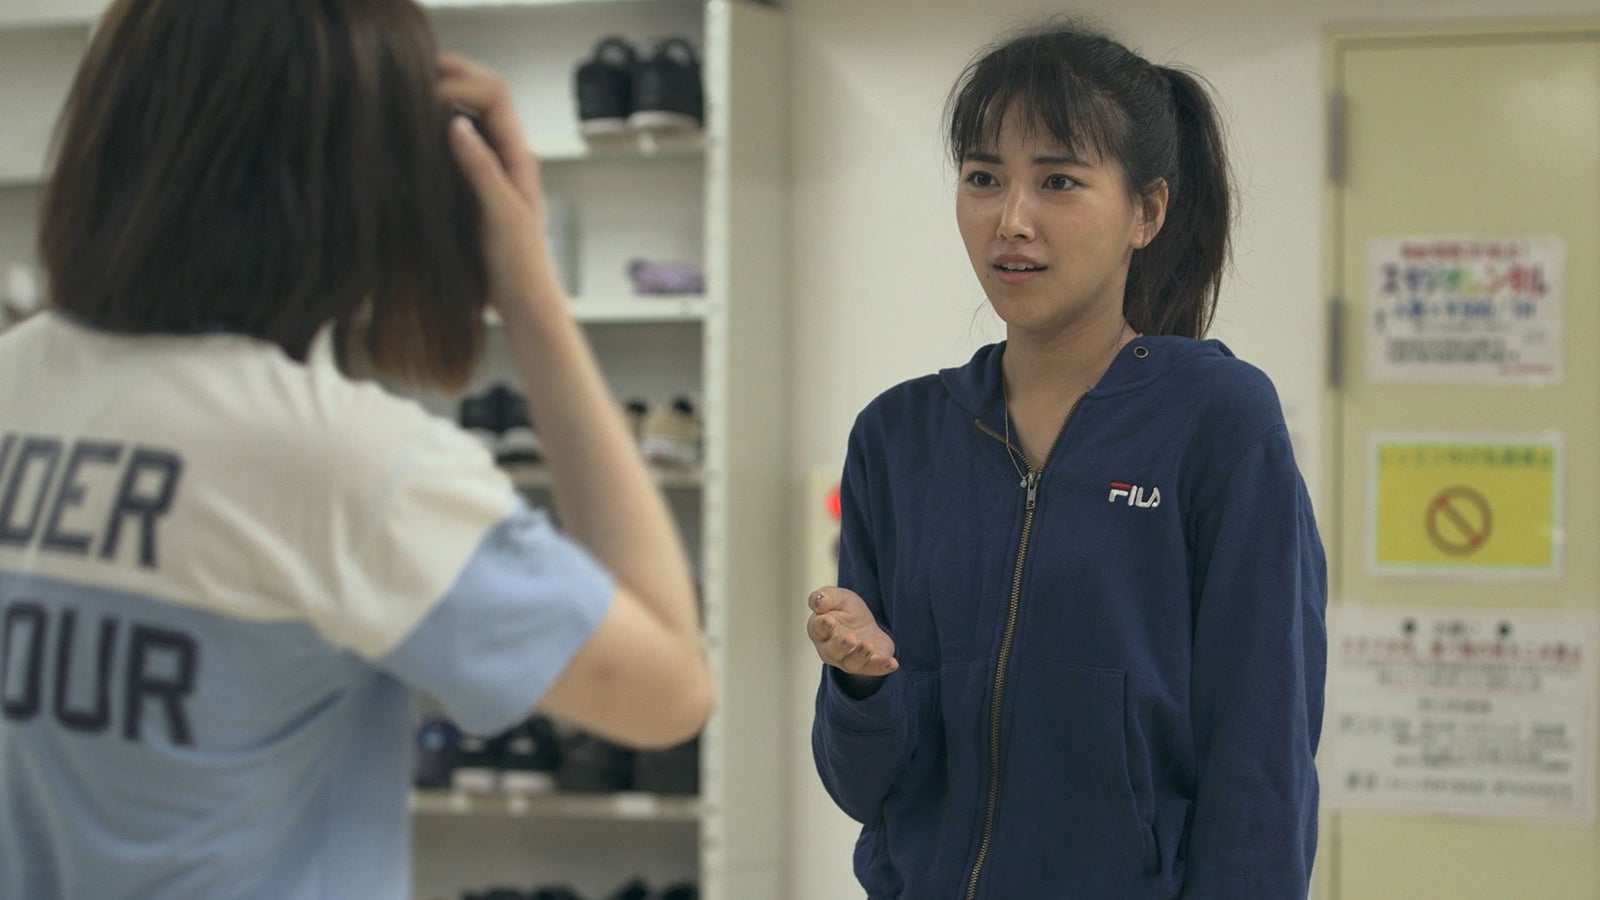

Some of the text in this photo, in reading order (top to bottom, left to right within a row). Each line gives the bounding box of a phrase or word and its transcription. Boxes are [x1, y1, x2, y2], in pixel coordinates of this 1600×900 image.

[0, 432, 185, 571] DER
[1108, 481, 1161, 508] FILA
[0, 600, 200, 747] OUR
